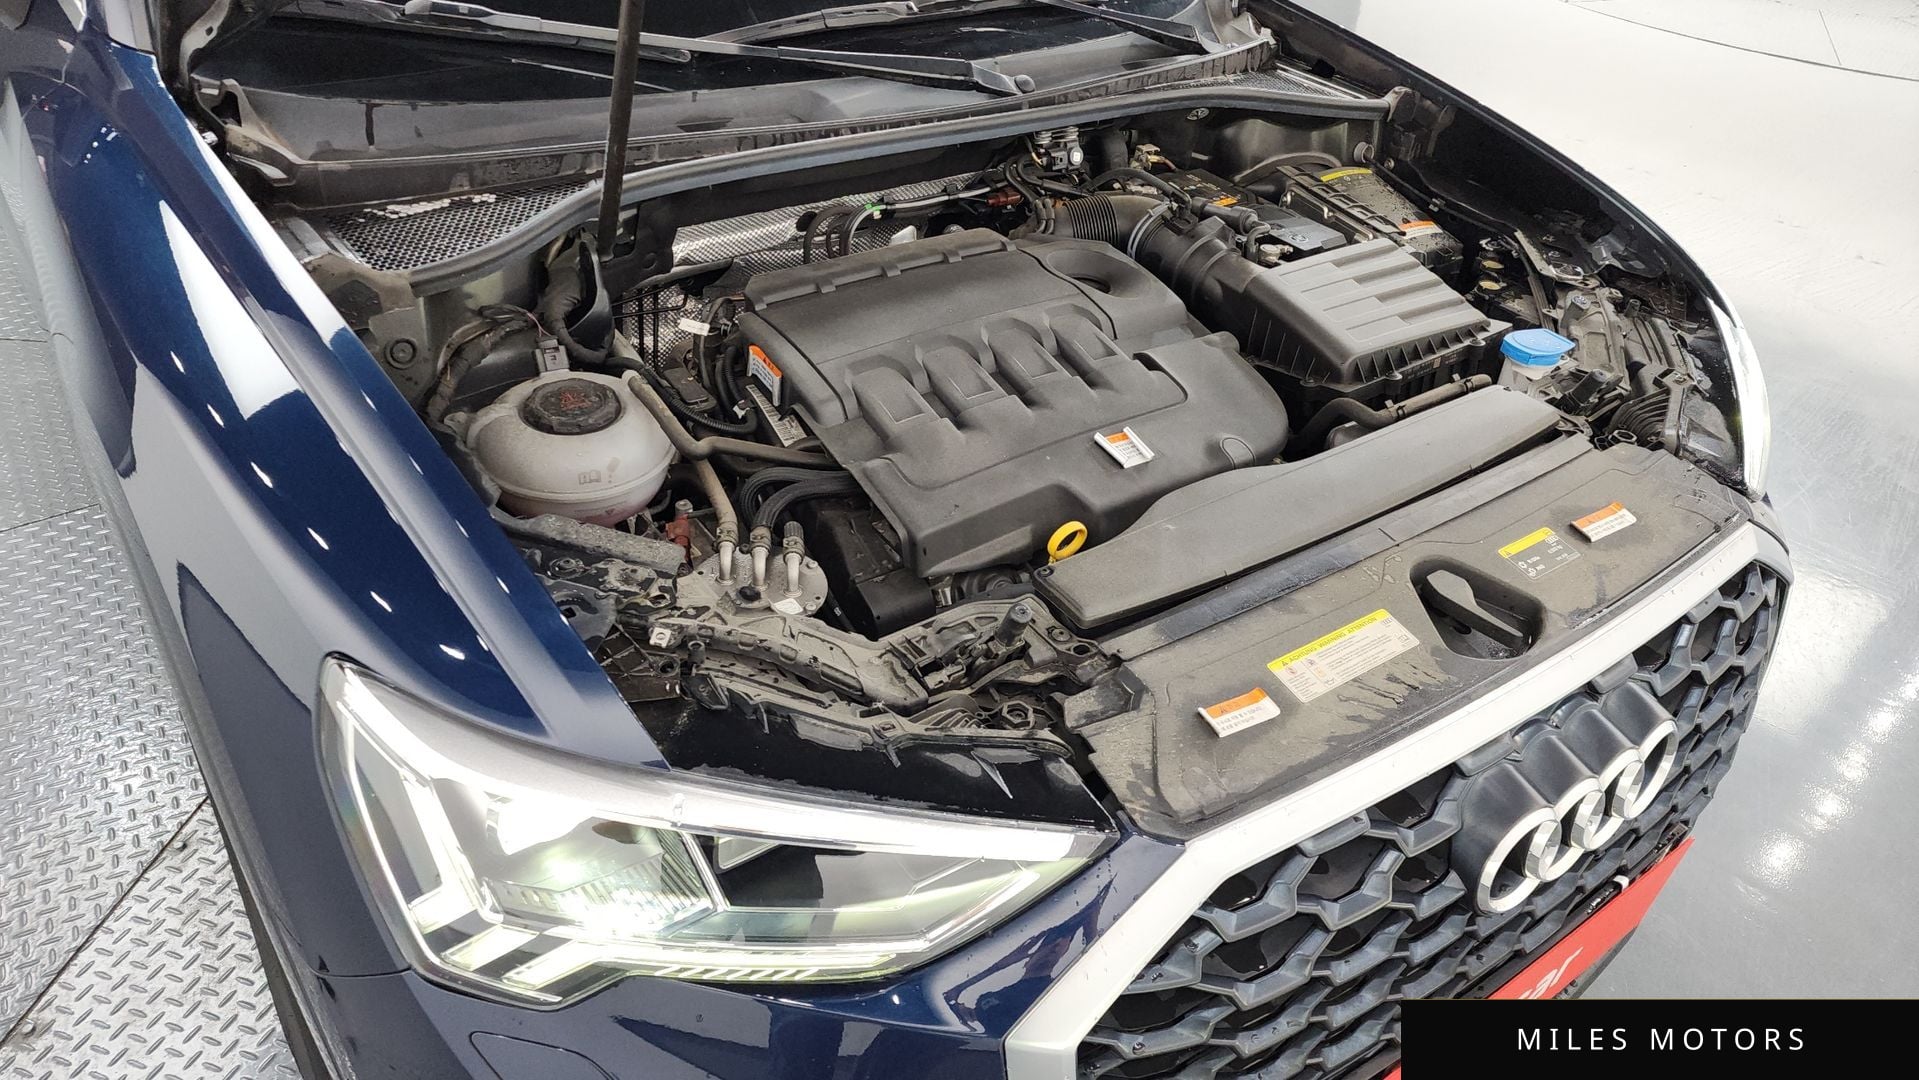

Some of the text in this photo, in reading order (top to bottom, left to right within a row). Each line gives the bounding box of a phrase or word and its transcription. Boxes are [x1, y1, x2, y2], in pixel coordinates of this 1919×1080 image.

[1288, 616, 1377, 663] ACHTUNG WARNING ATTENTION
